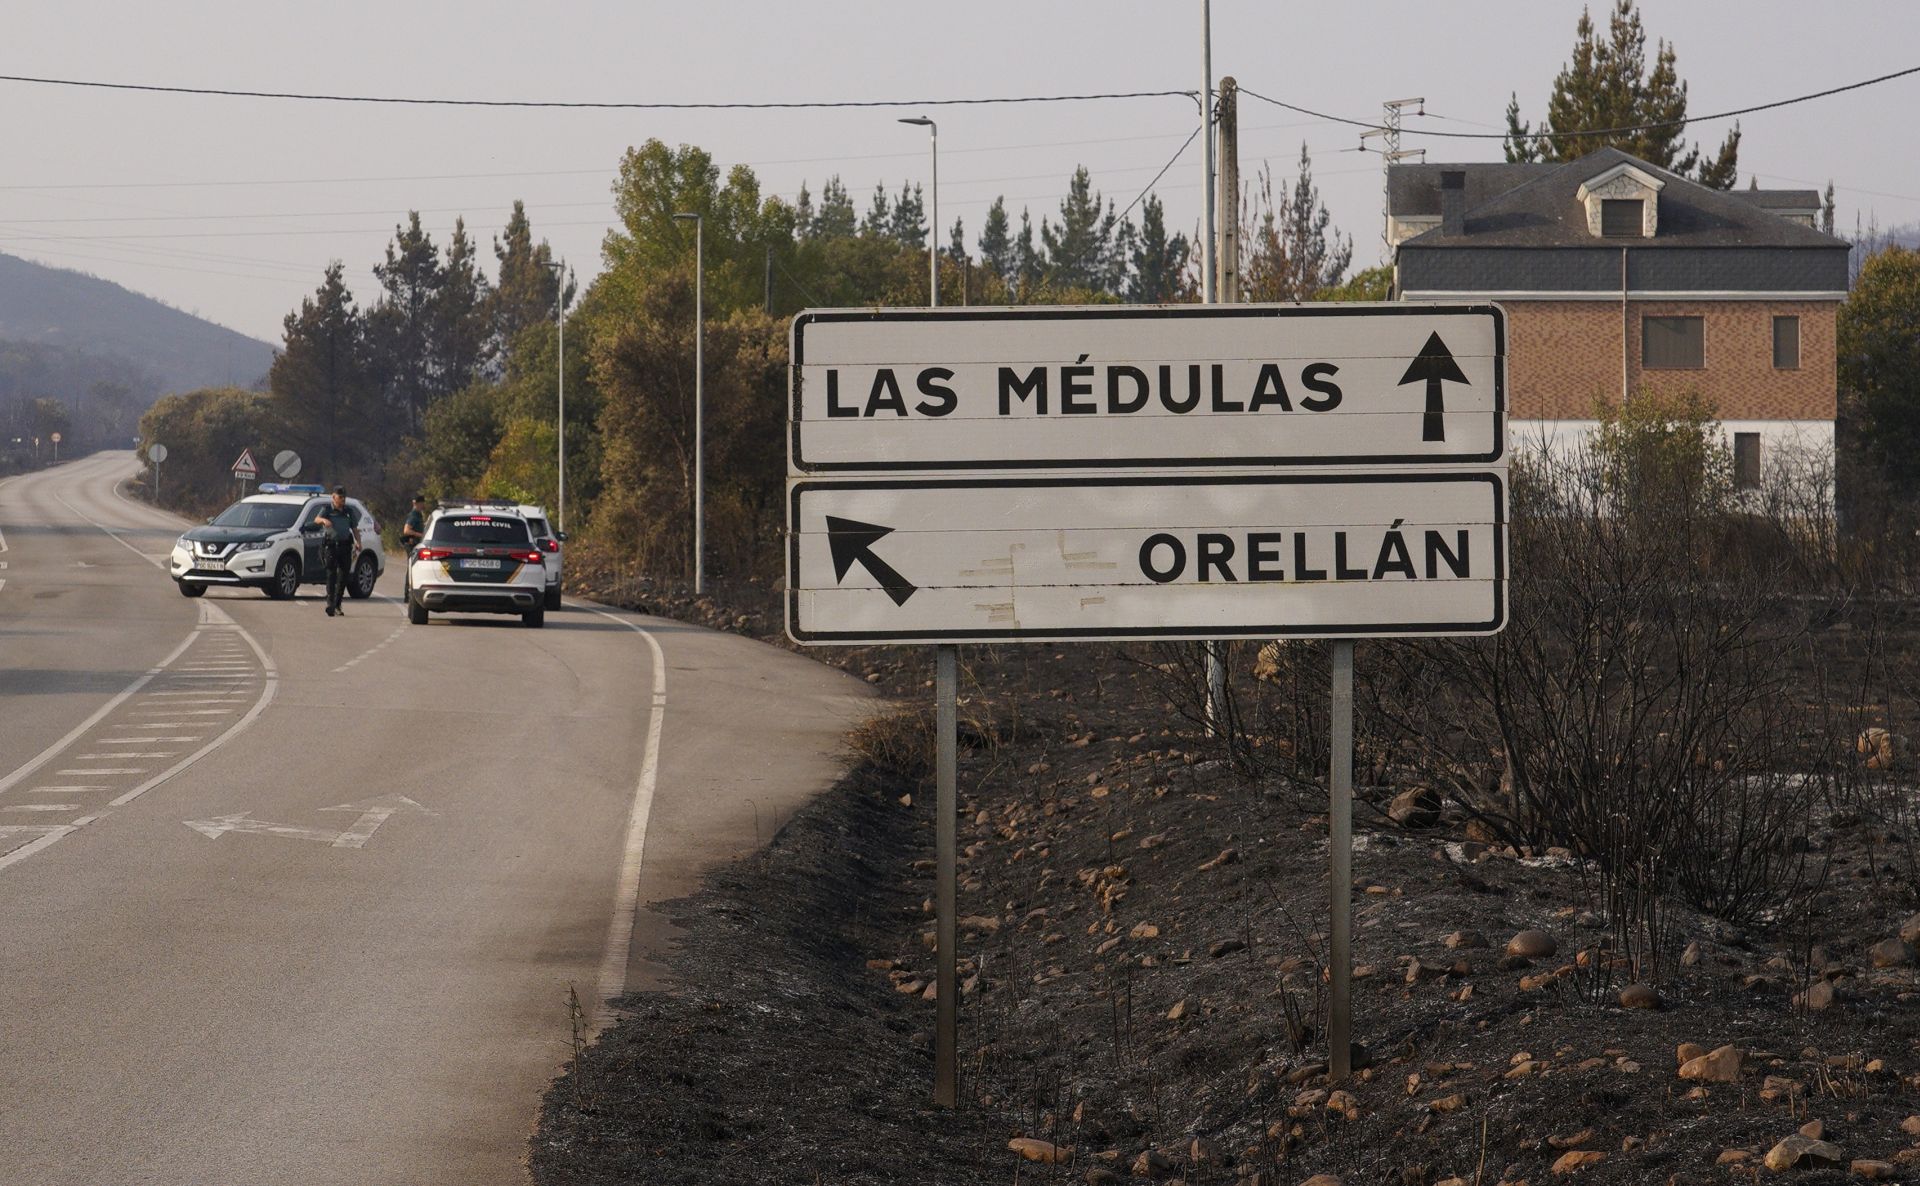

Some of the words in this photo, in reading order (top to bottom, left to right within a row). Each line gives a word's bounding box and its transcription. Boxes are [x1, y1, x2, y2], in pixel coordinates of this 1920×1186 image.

[826, 367, 958, 418] LAS
[998, 353, 1343, 416] MÉDULAS
[1138, 518, 1471, 584] ORELLÁN
